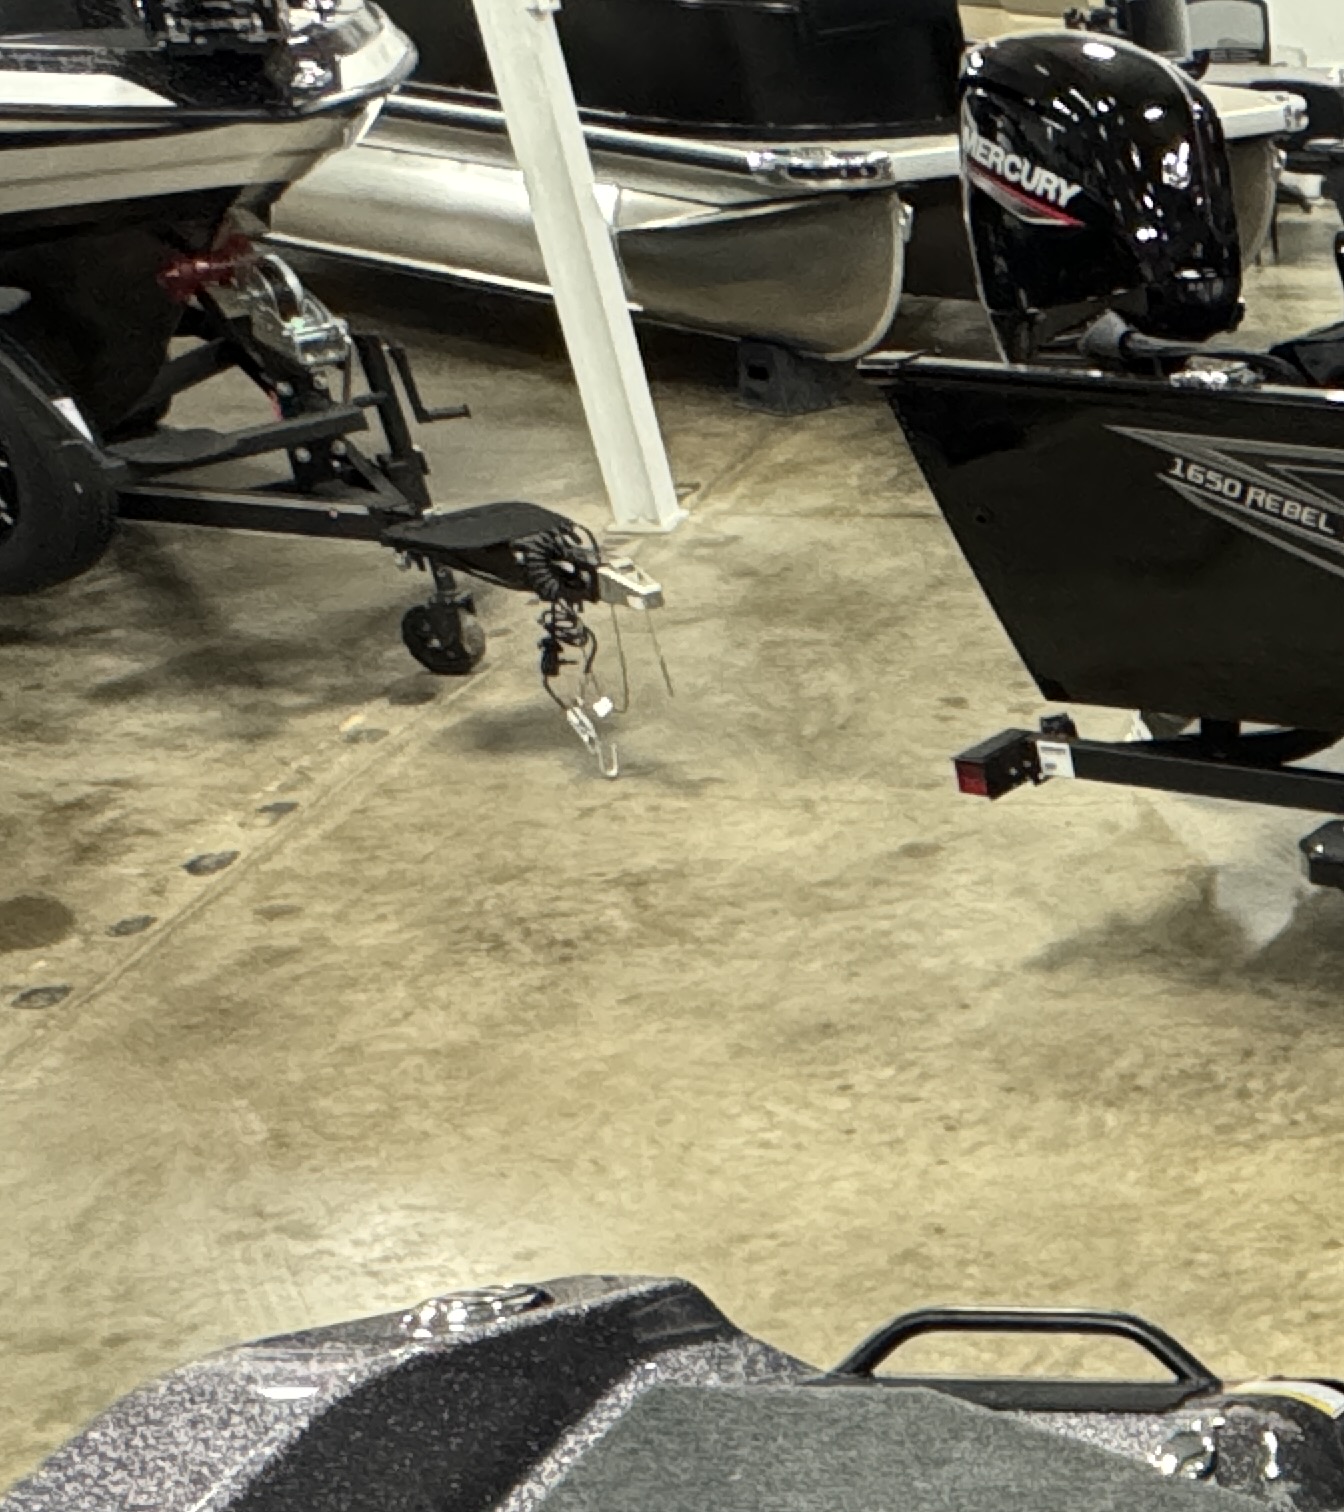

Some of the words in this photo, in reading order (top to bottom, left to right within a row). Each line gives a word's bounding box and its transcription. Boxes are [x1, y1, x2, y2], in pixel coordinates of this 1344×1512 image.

[962, 123, 1083, 208] MERCURY
[1168, 456, 1243, 500] 1650
[1244, 485, 1336, 536] REBEL
